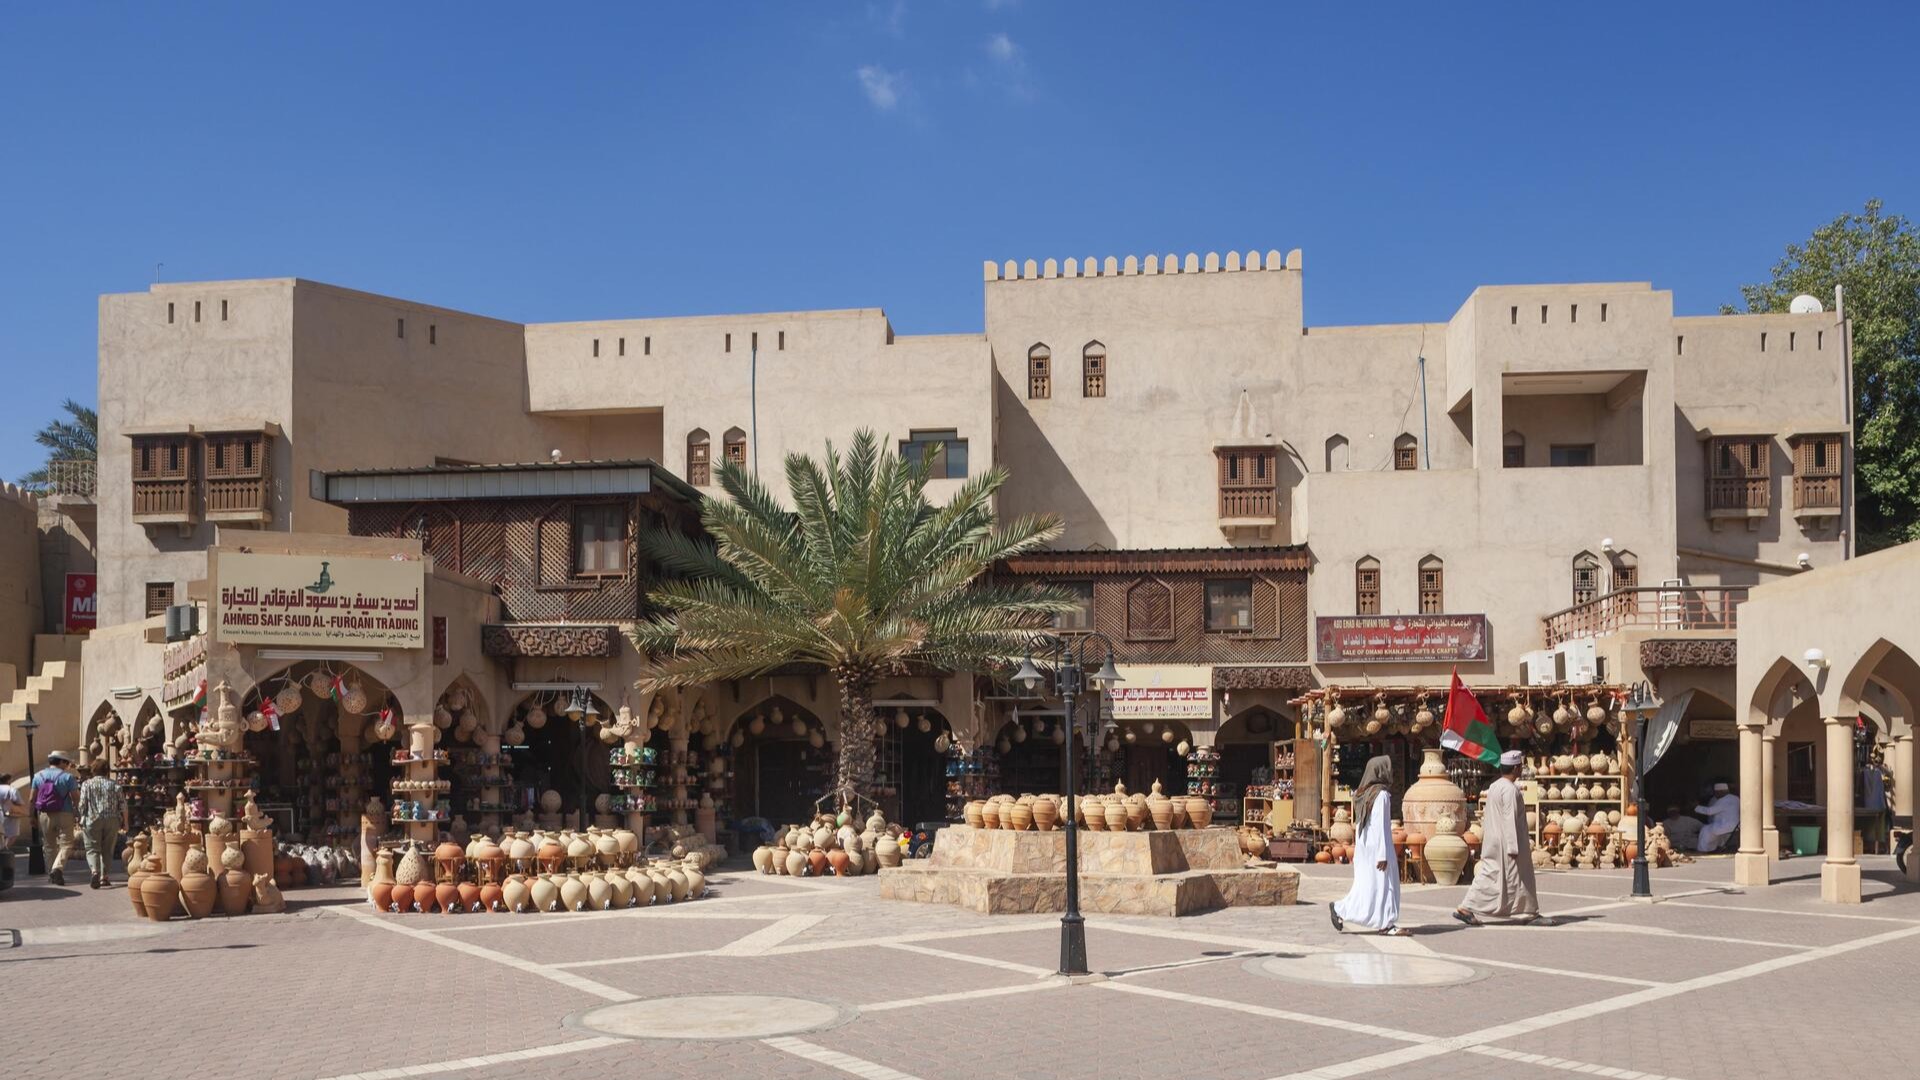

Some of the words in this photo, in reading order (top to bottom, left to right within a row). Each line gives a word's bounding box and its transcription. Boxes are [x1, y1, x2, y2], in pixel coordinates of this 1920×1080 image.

[222, 586, 258, 611] للتجارة
[260, 587, 304, 612] الفرقاني
[305, 595, 338, 613] سعود
[339, 595, 351, 615] بن
[353, 592, 379, 616] سيف
[380, 597, 392, 616] بن
[393, 587, 419, 611] أحمد
[223, 613, 259, 626] AHMED
[260, 613, 283, 627] SAIF
[284, 614, 311, 627] SAUD
[313, 615, 374, 630] AL-FURQANI
[375, 617, 419, 630] TRADING
